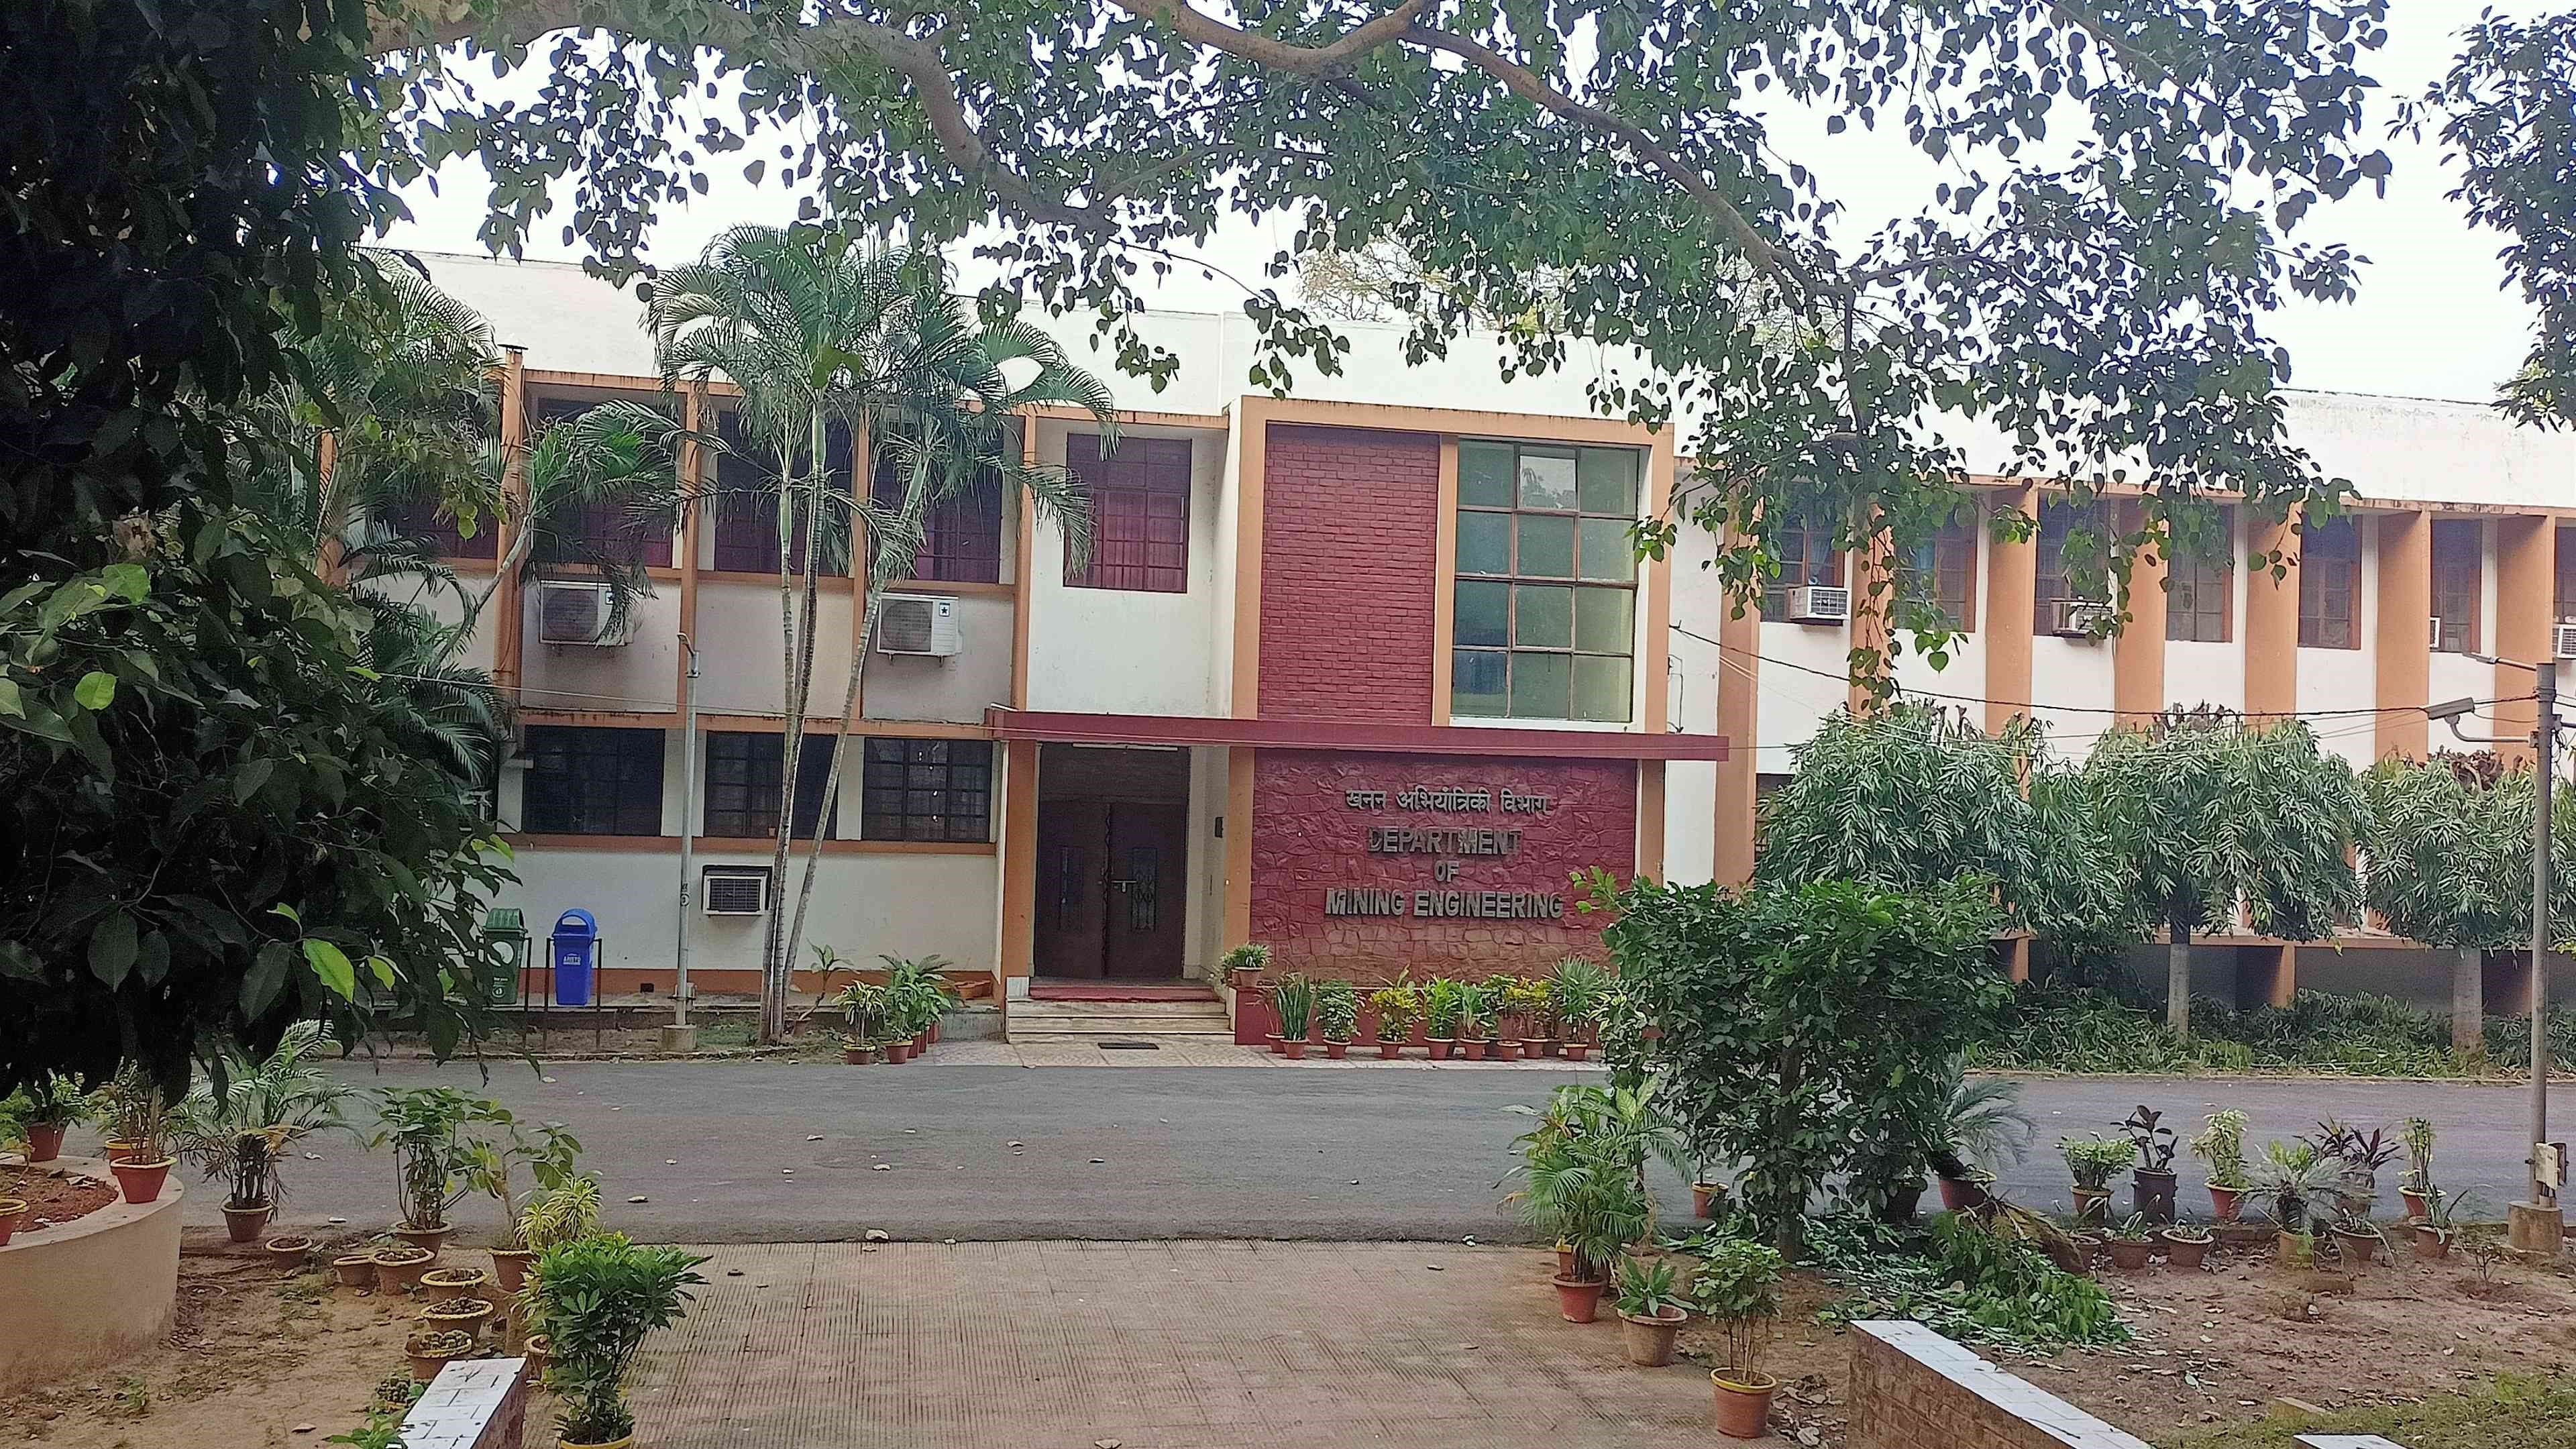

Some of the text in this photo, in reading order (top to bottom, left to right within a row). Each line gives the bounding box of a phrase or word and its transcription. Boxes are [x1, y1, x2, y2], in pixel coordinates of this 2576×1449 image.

[1347, 784, 1550, 815] खनन अभियांत्रिकी विभाग
[1368, 826, 1523, 855] DEPARTMENT
[1434, 859, 1459, 882] OF
[1325, 887, 1563, 919] MINING ENGINEERING
